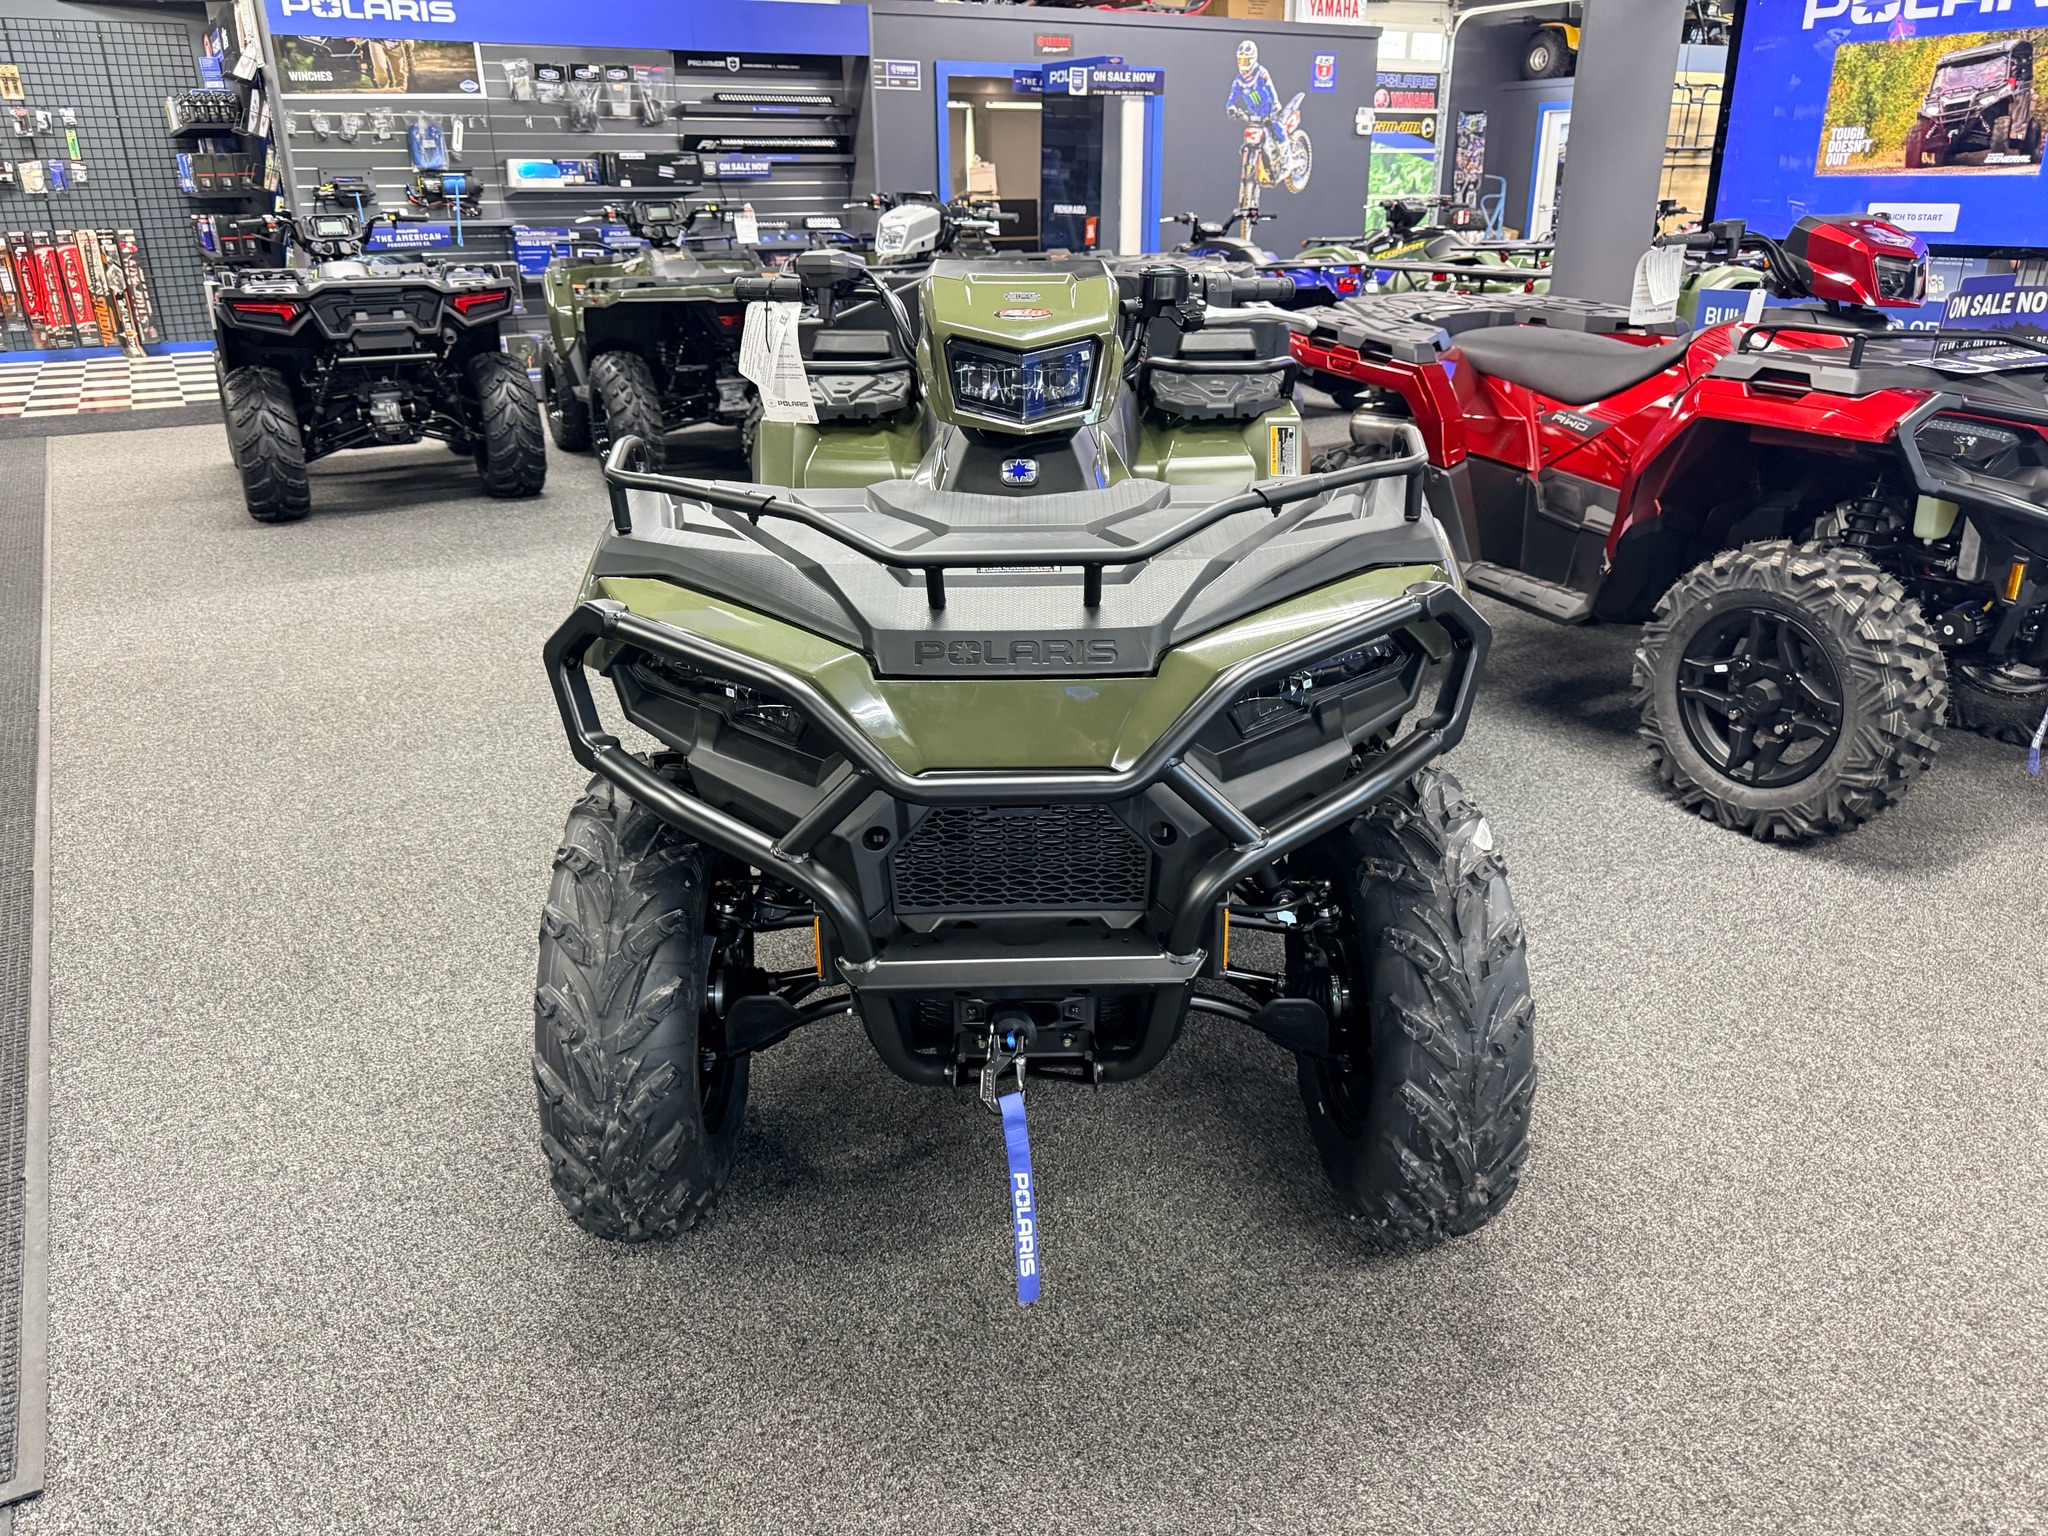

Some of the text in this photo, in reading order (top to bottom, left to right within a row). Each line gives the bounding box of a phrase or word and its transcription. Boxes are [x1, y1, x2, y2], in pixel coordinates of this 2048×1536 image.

[281, 0, 457, 23] POLARIS
[1310, 0, 1359, 18] YAMAHA
[289, 71, 333, 82] WINCHES
[1093, 70, 1156, 83] ON SALE NOW
[1376, 73, 1437, 89] POLARIS
[1390, 91, 1435, 109] YAMAHA
[1831, 126, 1865, 140] TOUGH
[1828, 139, 1872, 153] DOESN'T
[1825, 152, 1850, 167] QUIT
[1984, 155, 2031, 163] GENERAL
[719, 162, 769, 171] ON SALE NOW
[1907, 213, 1916, 221] TO
[1917, 213, 1943, 221] START
[375, 233, 441, 243] THE AMERICAN
[1949, 295, 1971, 320] ON
[1970, 292, 2015, 317] SALE
[777, 400, 809, 408] POLARIS
[1551, 413, 1589, 432] AWD
[914, 639, 1119, 667] POLARIS
[1013, 1172, 1036, 1278] POLARIS
